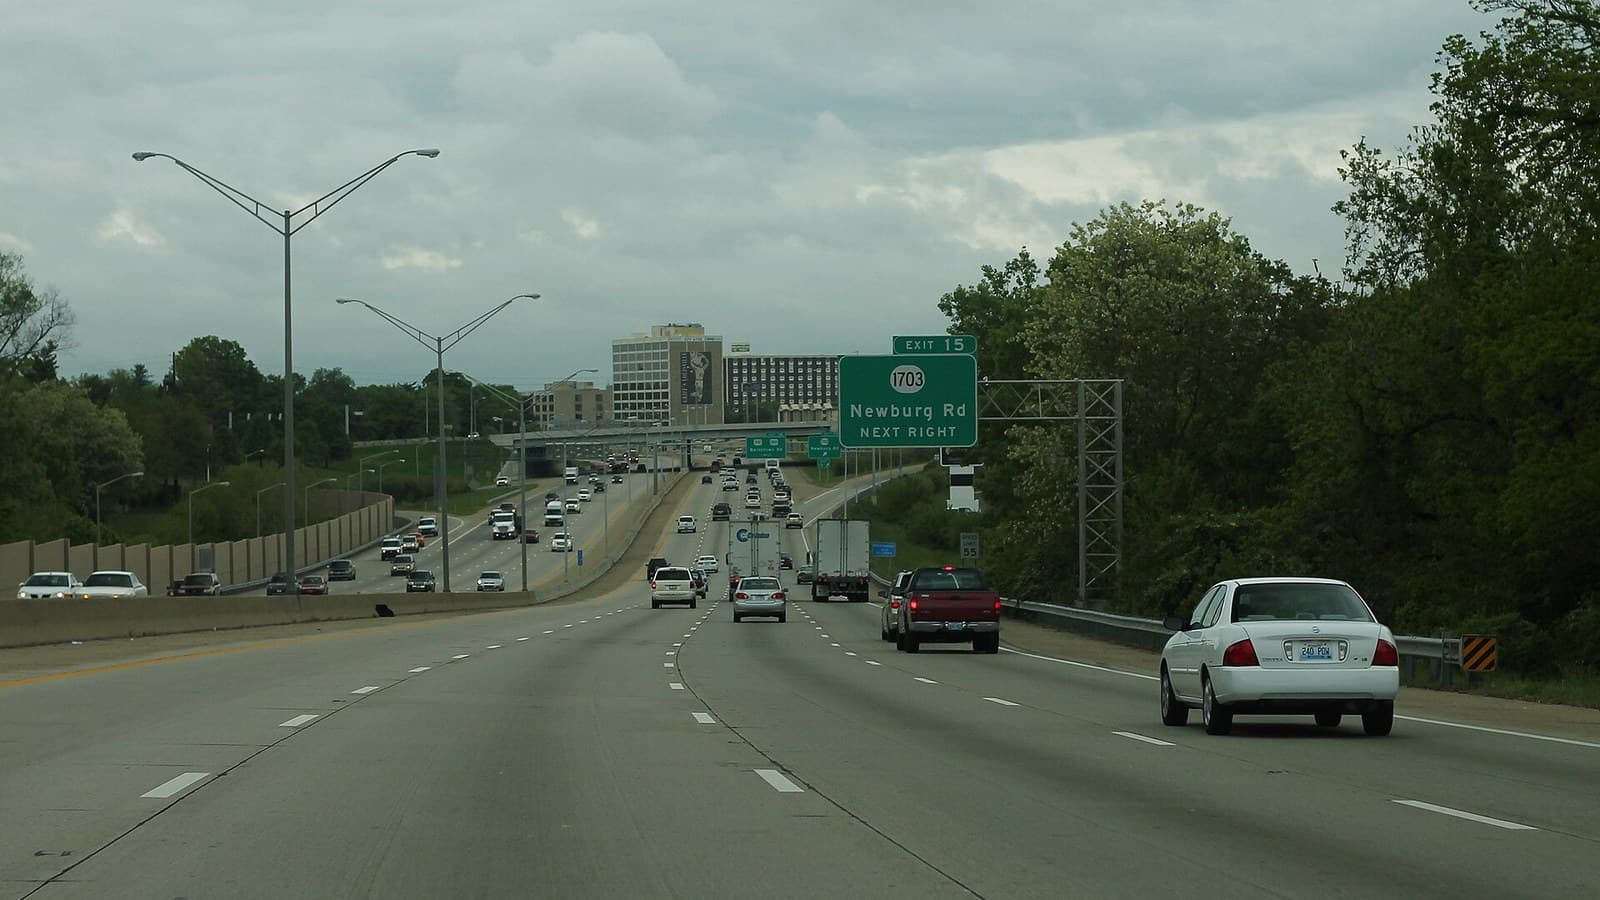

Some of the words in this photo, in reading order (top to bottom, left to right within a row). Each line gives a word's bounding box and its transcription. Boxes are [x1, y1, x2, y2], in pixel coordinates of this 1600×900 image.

[906, 340, 934, 349] EXIT
[945, 338, 964, 351] 15
[893, 371, 924, 387] 1703
[850, 403, 933, 421] Newburg
[944, 403, 966, 417] Rd
[860, 427, 900, 438] NEXT
[908, 426, 956, 438] RIGHT
[963, 547, 977, 557] 55
